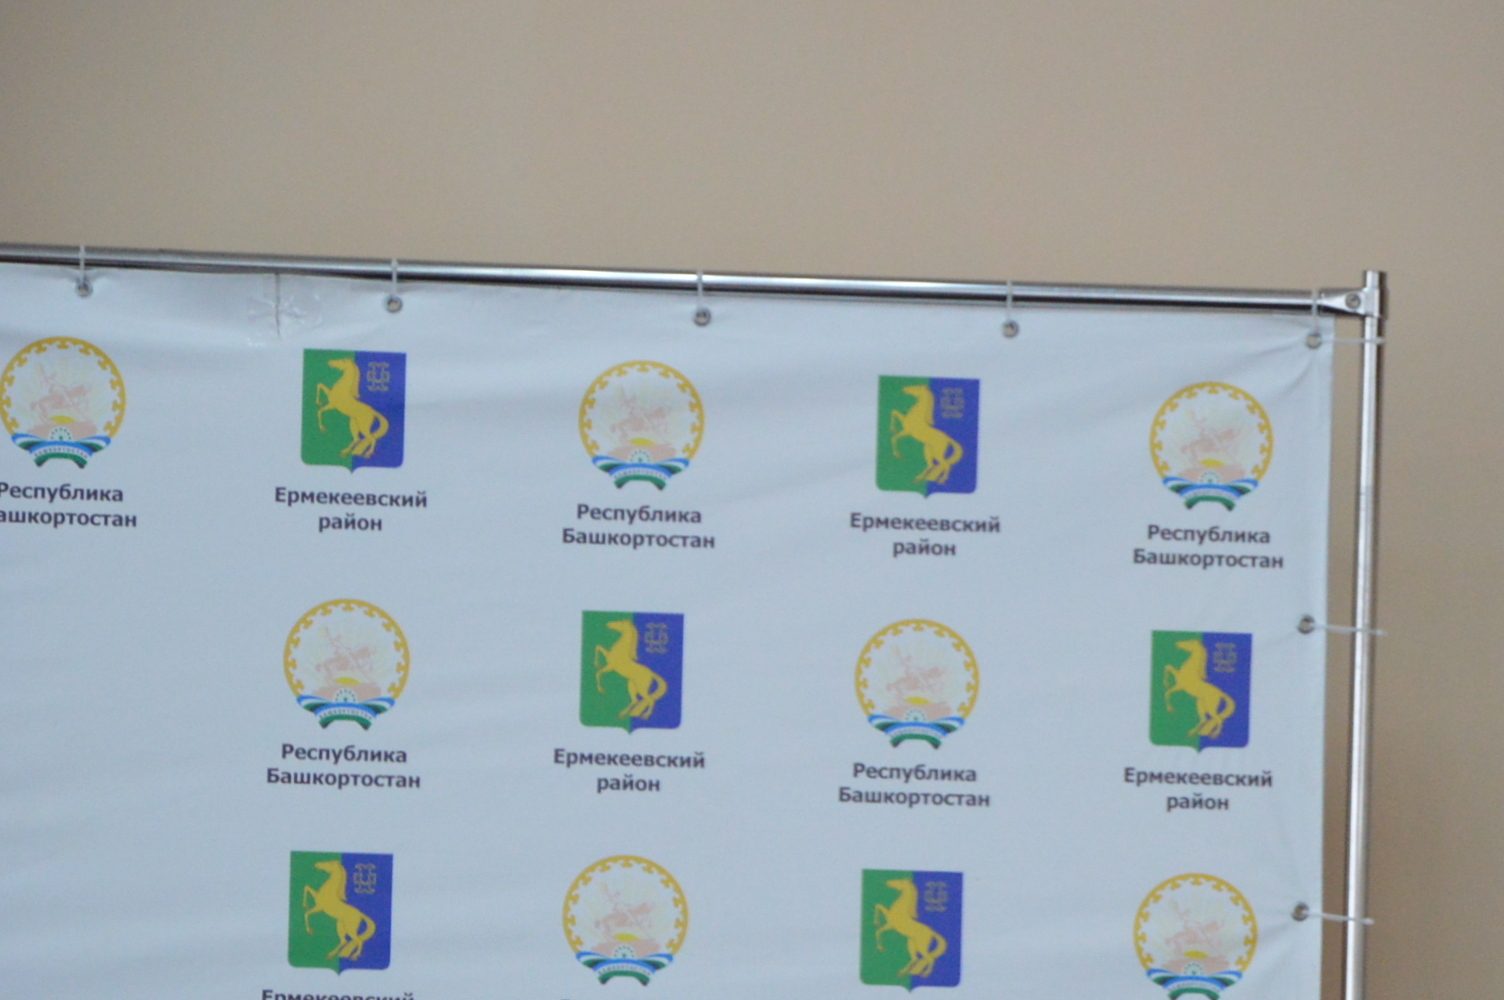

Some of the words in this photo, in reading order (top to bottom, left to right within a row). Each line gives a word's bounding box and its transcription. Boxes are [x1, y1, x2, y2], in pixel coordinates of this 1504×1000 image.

[0, 481, 124, 504] Республика
[274, 486, 428, 508] Ермекеевский
[0, 509, 138, 529] ашкортостан
[318, 513, 383, 533] район
[576, 503, 702, 525] Республика
[849, 511, 1001, 533] Ермекеевский
[562, 527, 715, 550] Башкортостан
[1147, 524, 1271, 546] Республика
[892, 538, 957, 558] район
[1133, 547, 1284, 571] Башкортостан
[281, 743, 407, 765] Республика
[553, 748, 705, 769] Ермекеевский
[266, 767, 421, 790] Башкортостан
[596, 774, 661, 794] район
[852, 762, 977, 784] Республика
[1123, 766, 1273, 788] Ермекеевский
[838, 786, 991, 809] Башкортостан
[1166, 792, 1230, 813] район
